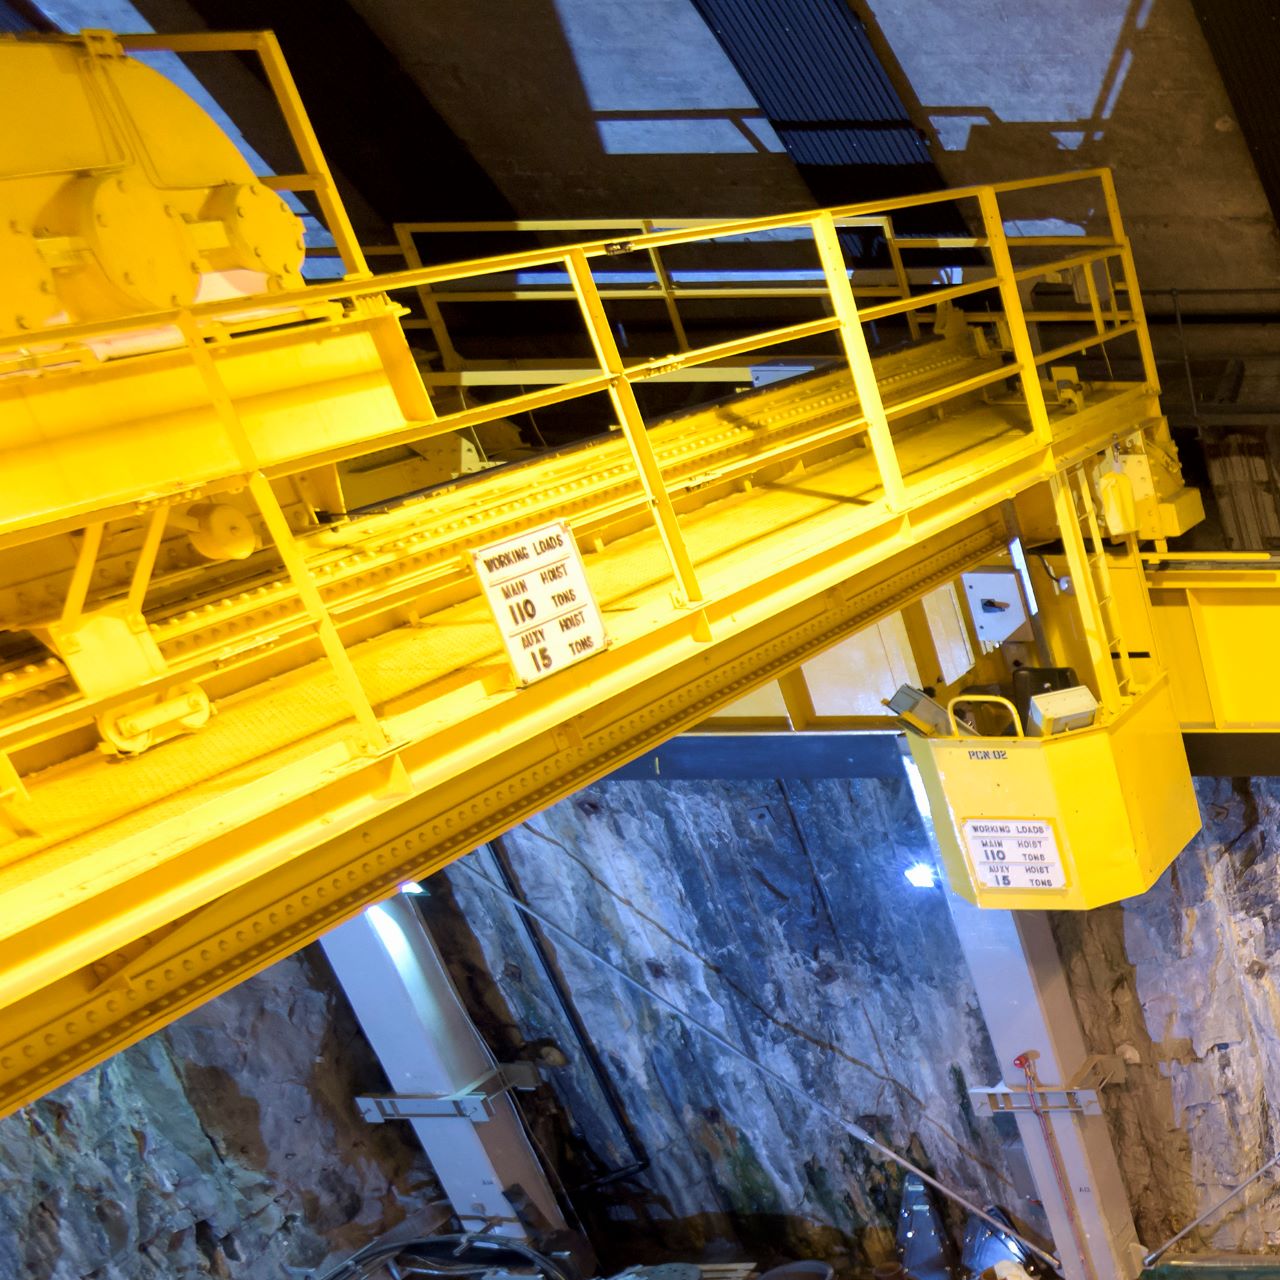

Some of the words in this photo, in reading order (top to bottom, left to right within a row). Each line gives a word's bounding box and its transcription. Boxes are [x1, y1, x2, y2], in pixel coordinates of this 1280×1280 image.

[483, 546, 530, 573] WORKING
[532, 534, 564, 556] LOADS
[501, 579, 529, 600] MAIN
[539, 563, 569, 585] HOIST
[508, 599, 537, 626] 110
[551, 588, 577, 608] TONS
[520, 629, 546, 650] AUXY
[558, 611, 586, 633] HOIST
[531, 647, 553, 673] 15
[568, 635, 594, 656] TONS
[972, 825, 1011, 834] WORKING
[1016, 826, 1045, 834] LOADS
[981, 840, 1004, 848] MAIN
[1017, 840, 1043, 849] HOIST
[984, 849, 1006, 861] 110
[1022, 853, 1046, 862] TONS
[989, 866, 1010, 874] AUXY
[1025, 866, 1050, 875] HOIST
[994, 875, 1011, 886] 15
[1029, 879, 1053, 887] TONS
